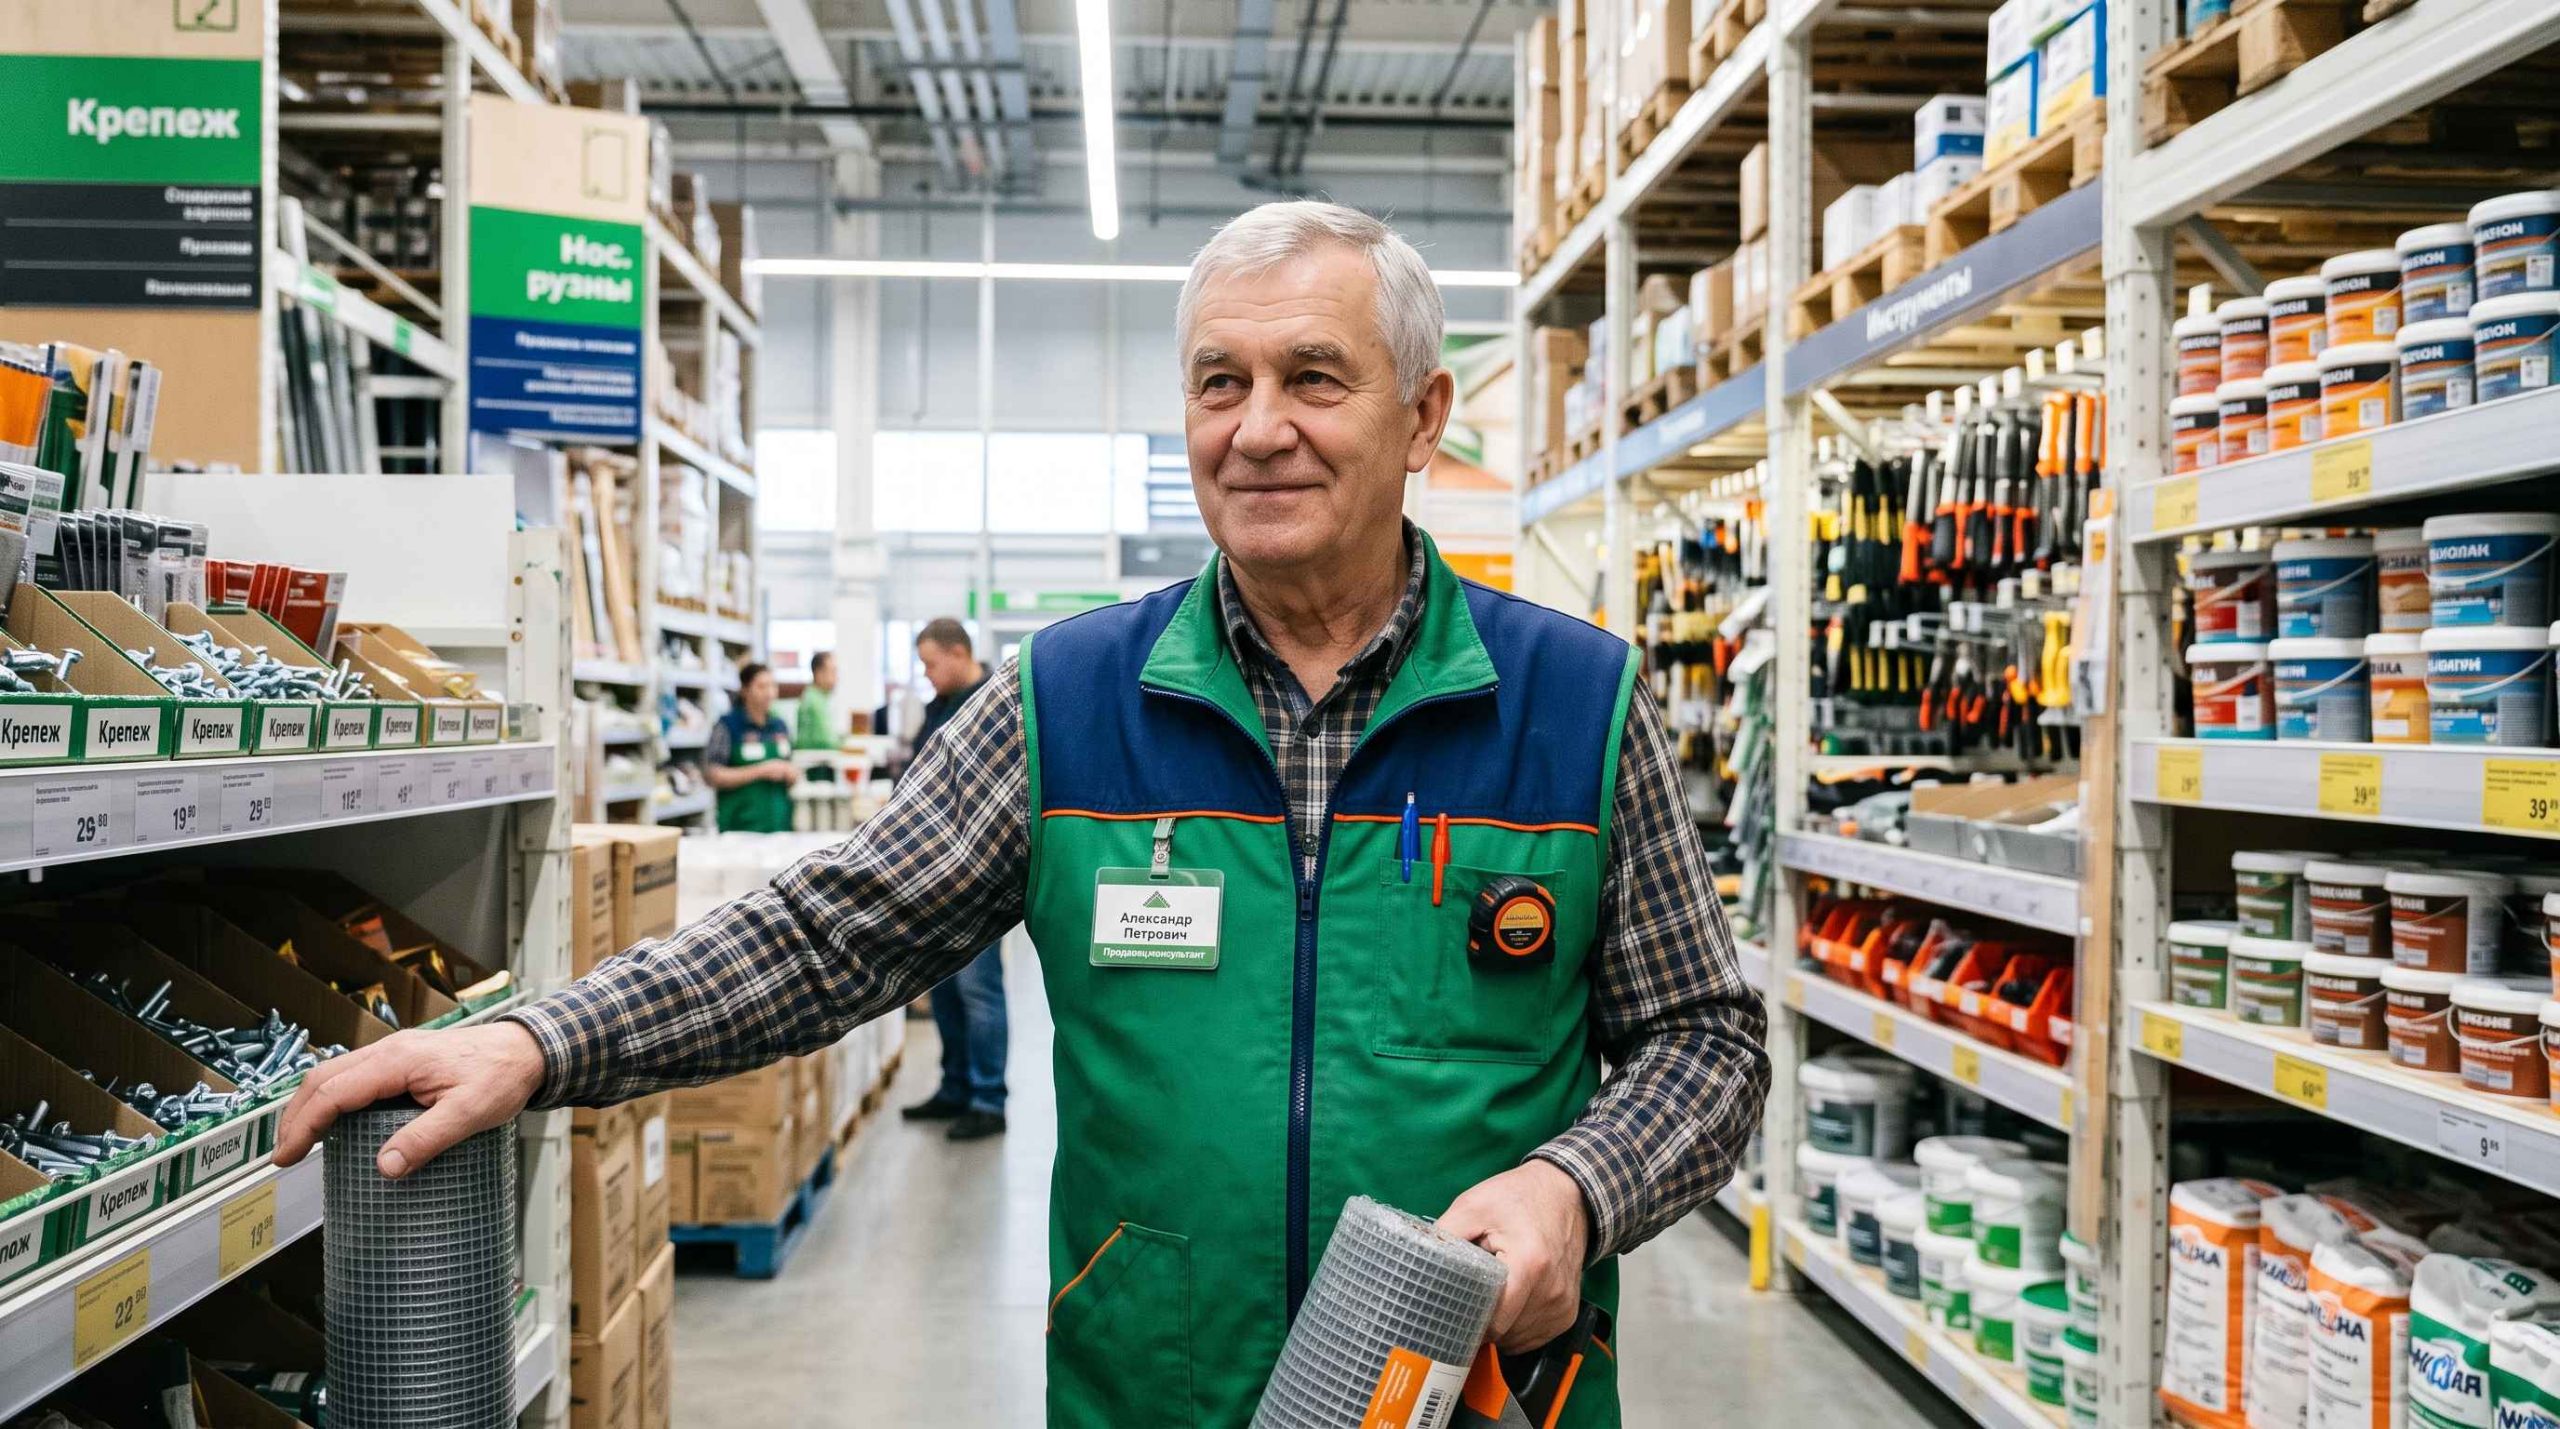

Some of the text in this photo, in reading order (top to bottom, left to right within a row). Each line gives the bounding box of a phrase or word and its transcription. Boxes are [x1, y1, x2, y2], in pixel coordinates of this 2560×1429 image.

[67, 98, 240, 143] Крепеж
[560, 234, 632, 270] Нос.
[1866, 266, 1972, 342] Инструменты
[2, 718, 61, 750] Крепеж
[99, 720, 151, 748] Крепеж
[192, 718, 233, 744] Крепеж
[269, 718, 306, 743] Крепеж
[333, 718, 366, 741] Крепеж
[173, 806, 187, 831] 19
[2529, 798, 2547, 820] 39
[1120, 912, 1192, 927] Александр
[1124, 928, 1187, 941] Петрович
[201, 1133, 241, 1168] Крепеж
[2480, 1137, 2488, 1157] 9
[99, 1178, 149, 1220] Крепеж
[115, 1298, 133, 1330] 22
